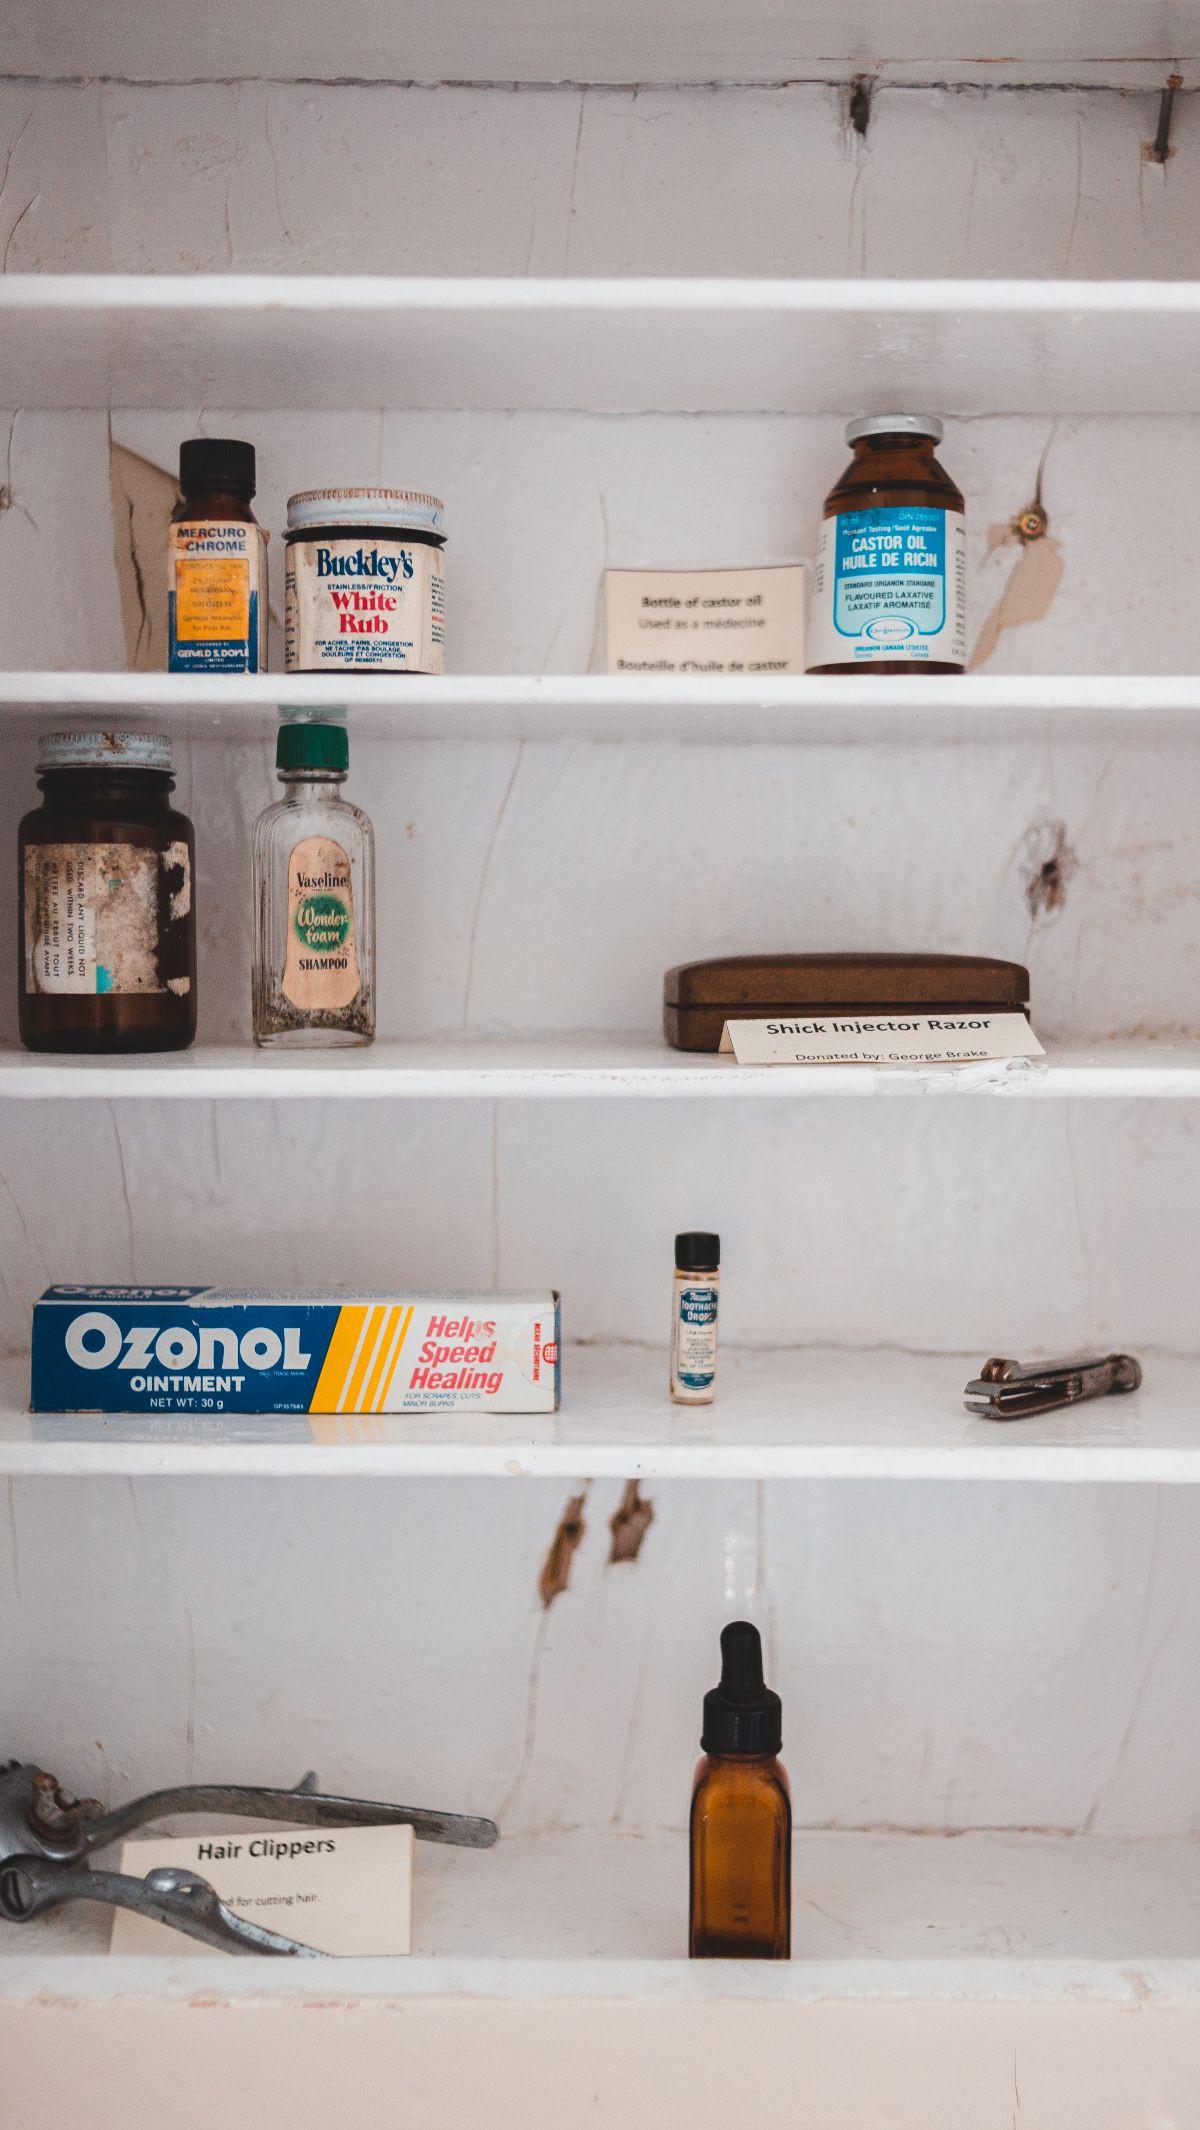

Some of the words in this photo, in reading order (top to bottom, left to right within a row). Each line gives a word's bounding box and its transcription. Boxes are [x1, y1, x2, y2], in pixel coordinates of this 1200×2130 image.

[177, 528, 246, 538] MERCURO
[186, 541, 247, 552] CHROME
[852, 535, 903, 553] CASTOR
[906, 535, 928, 550] OIL
[317, 547, 414, 583] Buckley's
[842, 553, 877, 571] HUILE
[881, 552, 899, 567] DE
[903, 552, 938, 567] RICIN
[327, 584, 403, 592] STAINLESS/FRICTION
[844, 580, 873, 590] STANDARD
[874, 580, 904, 588] ORGANON
[906, 580, 935, 588] STANDARD
[330, 590, 398, 611] White
[641, 596, 681, 608] Bottle
[685, 596, 700, 608] of
[702, 597, 742, 608] castor
[745, 594, 762, 607] oil
[845, 592, 893, 602] FLAVOURED
[895, 592, 934, 600] LAXATIVE
[847, 602, 881, 612] LAXATIF
[883, 600, 931, 610] AROMATISÉ
[339, 613, 389, 634] Rub
[638, 618, 671, 630] Used
[674, 620, 688, 630] as
[691, 620, 699, 630] a
[373, 640, 414, 648] CONGESTION
[177, 649, 212, 658] GERALD
[221, 648, 250, 658] DOYLE
[617, 659, 675, 671] Bouteille
[679, 659, 724, 672] d'huile
[728, 660, 743, 672] de
[748, 660, 788, 671] castor
[51, 863, 59, 896] METTRE
[77, 862, 85, 900] DISCARD
[297, 872, 348, 888] Vaseline
[52, 902, 59, 914] AU
[66, 888, 74, 918] WITHIN
[77, 903, 85, 921] ANY
[52, 920, 60, 948] REBUT
[78, 924, 86, 955] LIQUID
[305, 926, 340, 944] foam
[78, 958, 86, 977] NOT
[299, 958, 348, 971] SHAMPOO
[766, 1022, 825, 1035] Shick
[833, 1020, 920, 1034] Injector
[928, 1018, 991, 1031] Razor
[795, 1052, 859, 1062] Donated
[862, 1051, 885, 1063] by:
[889, 1051, 942, 1062] George
[947, 1049, 988, 1059] Brake
[426, 1315, 497, 1343] Helps
[418, 1341, 497, 1367] Speed
[533, 1344, 541, 1382] SÉCURITAIRE
[130, 1376, 245, 1392] OINTMENT
[408, 1367, 503, 1394] Healing
[150, 1398, 172, 1408] NET
[176, 1398, 198, 1408] WT:
[201, 1398, 215, 1408] 30
[216, 1399, 224, 1410] g
[197, 1843, 242, 1861] Hair
[249, 1838, 336, 1860] Clippers
[236, 1895, 252, 1906] for
[255, 1894, 294, 1907] cutting
